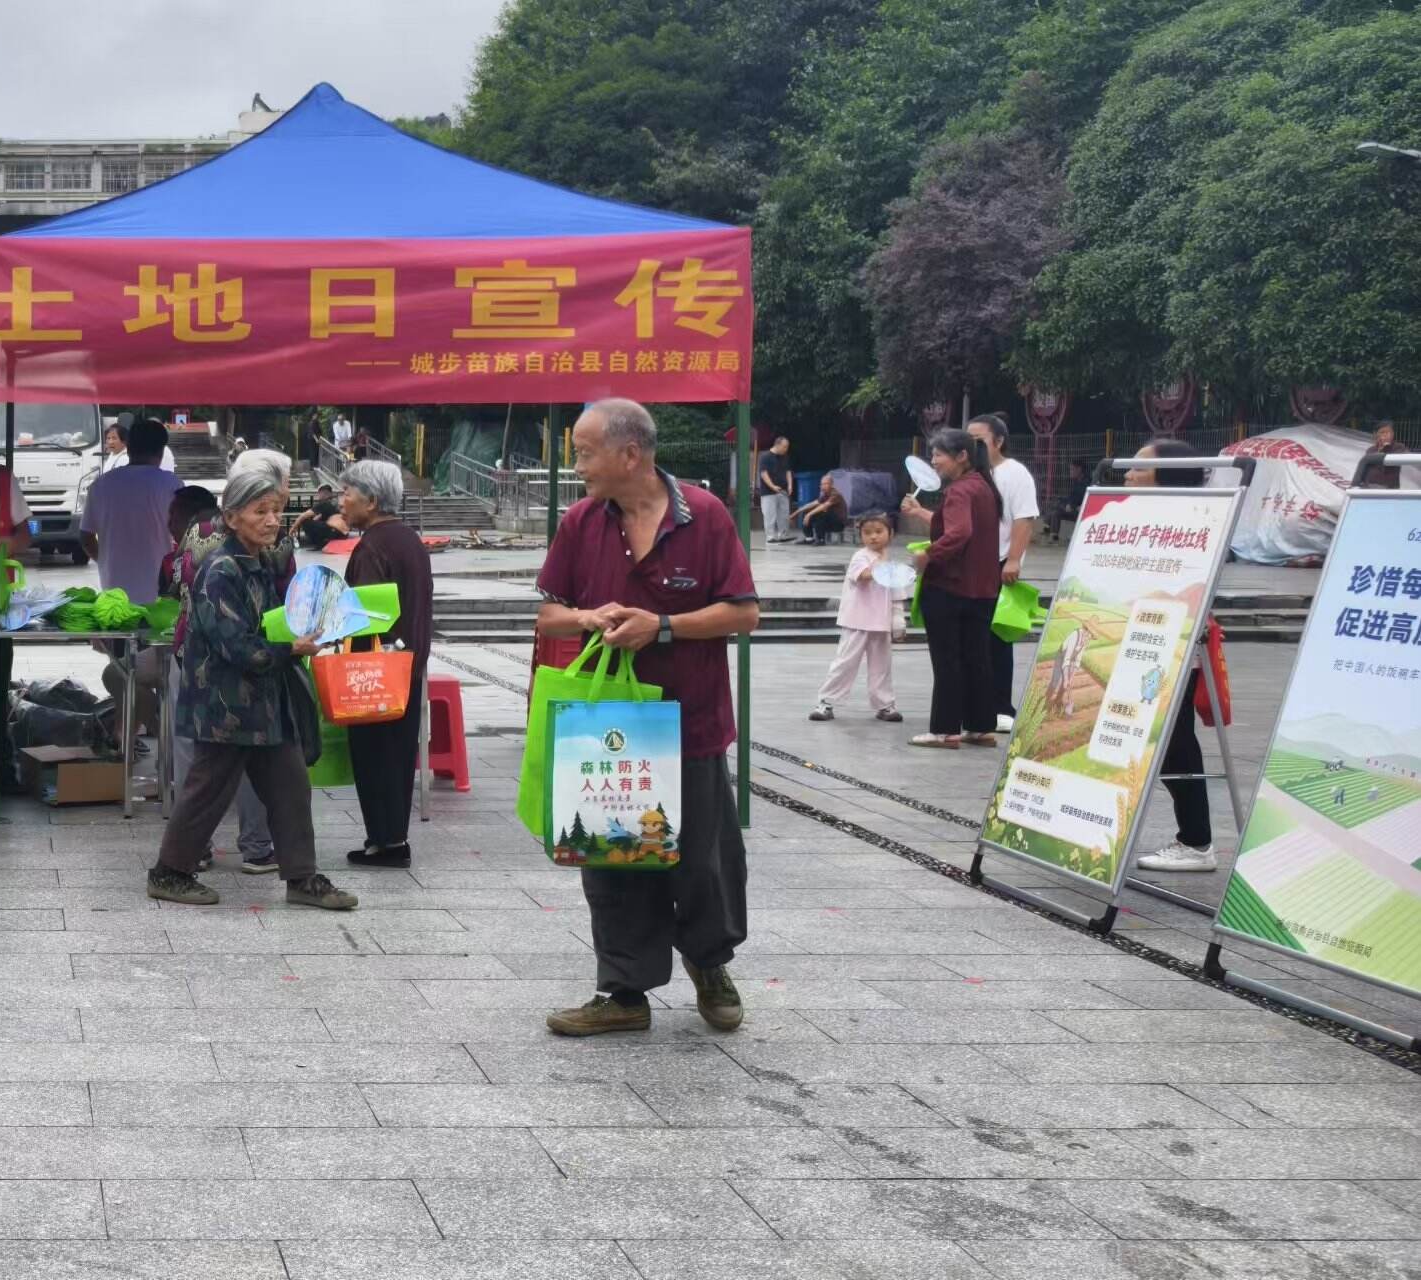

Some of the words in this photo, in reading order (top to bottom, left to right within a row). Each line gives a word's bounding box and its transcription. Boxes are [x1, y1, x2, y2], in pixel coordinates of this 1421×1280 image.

[409, 350, 741, 374] 城步苗族自治县自然资源局
[1083, 522, 1211, 552] 全国土地日严守耕地红线
[579, 759, 652, 775] 森林防火
[580, 776, 653, 793] 人人有责
